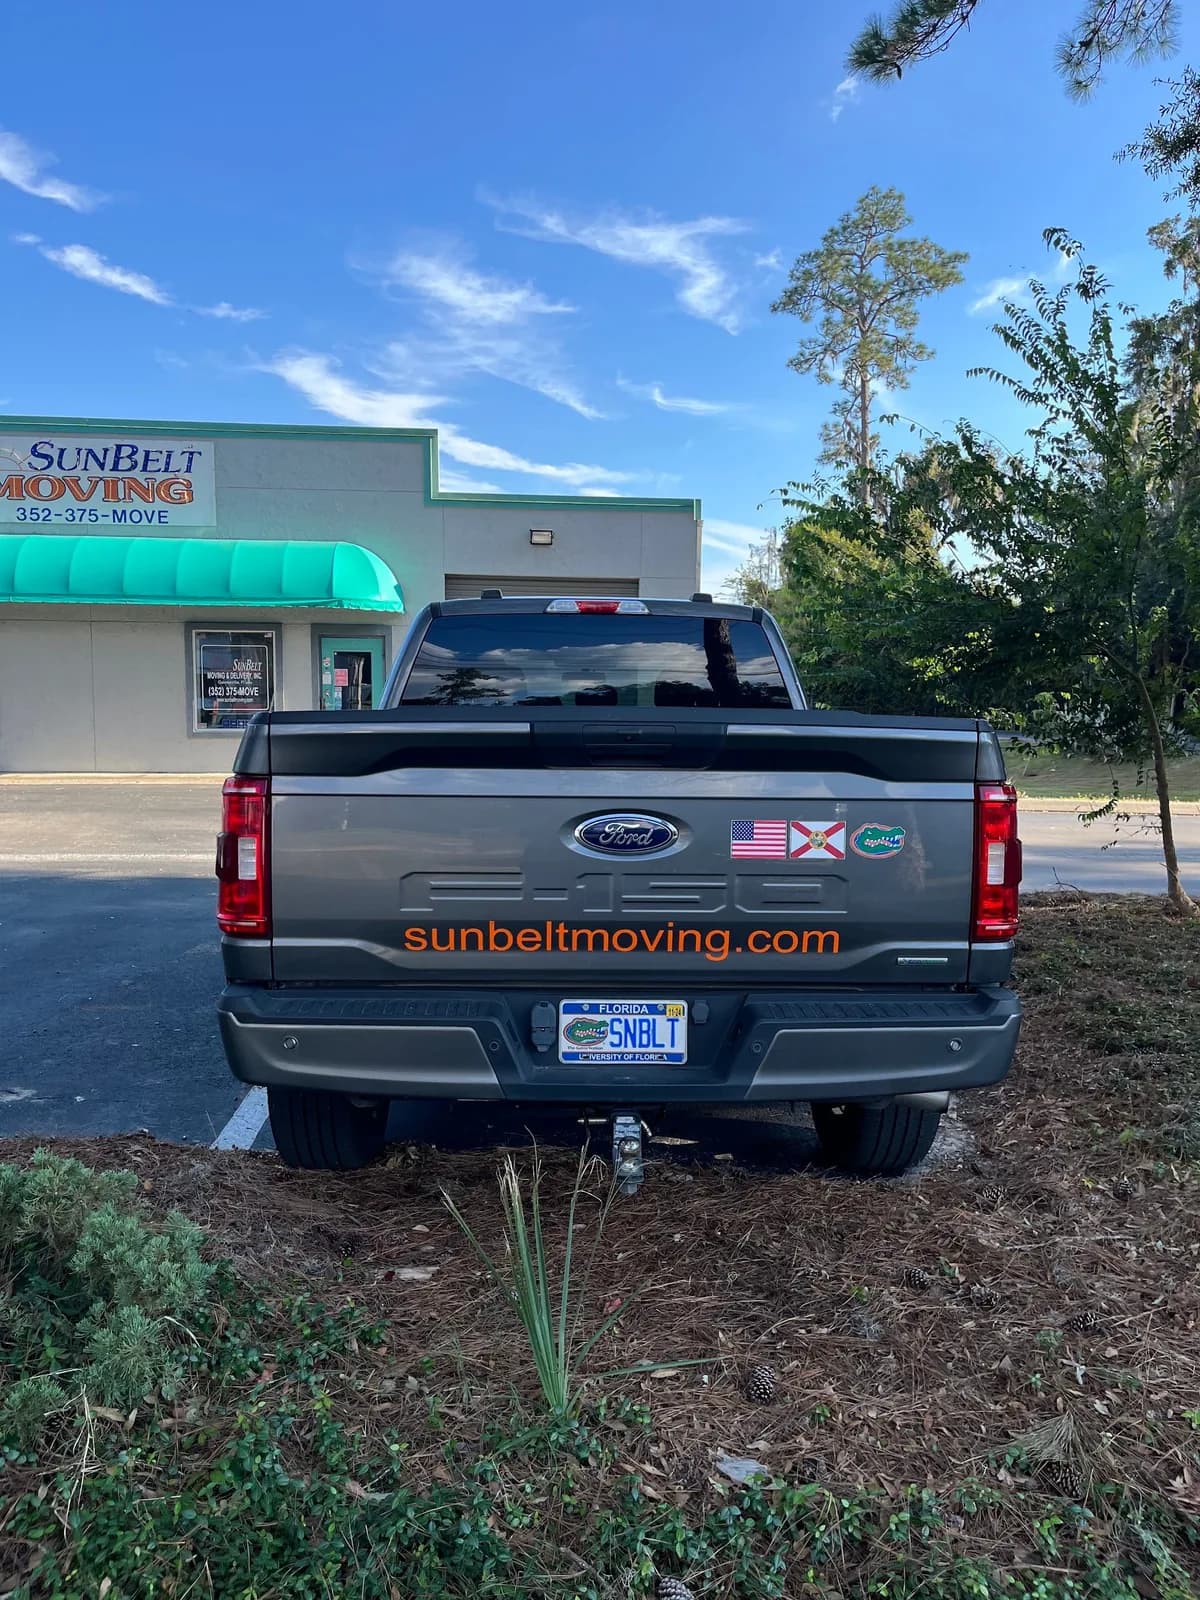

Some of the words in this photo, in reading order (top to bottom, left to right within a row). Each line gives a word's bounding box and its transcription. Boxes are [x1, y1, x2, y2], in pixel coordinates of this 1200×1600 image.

[16, 507, 169, 524] 352-375-MOVE
[207, 672, 225, 680] MOVING
[208, 686, 225, 697] (352)
[226, 687, 259, 696] 375-MOVE
[599, 822, 654, 845] Ford
[404, 920, 840, 961] sunbeltmoving.com
[600, 1004, 649, 1014] FLORIDA
[609, 1017, 680, 1049] SNBLT
[578, 1053, 622, 1061] UIVERSITY
[623, 1053, 635, 1061] OF
[635, 1053, 668, 1061] FLORIA
